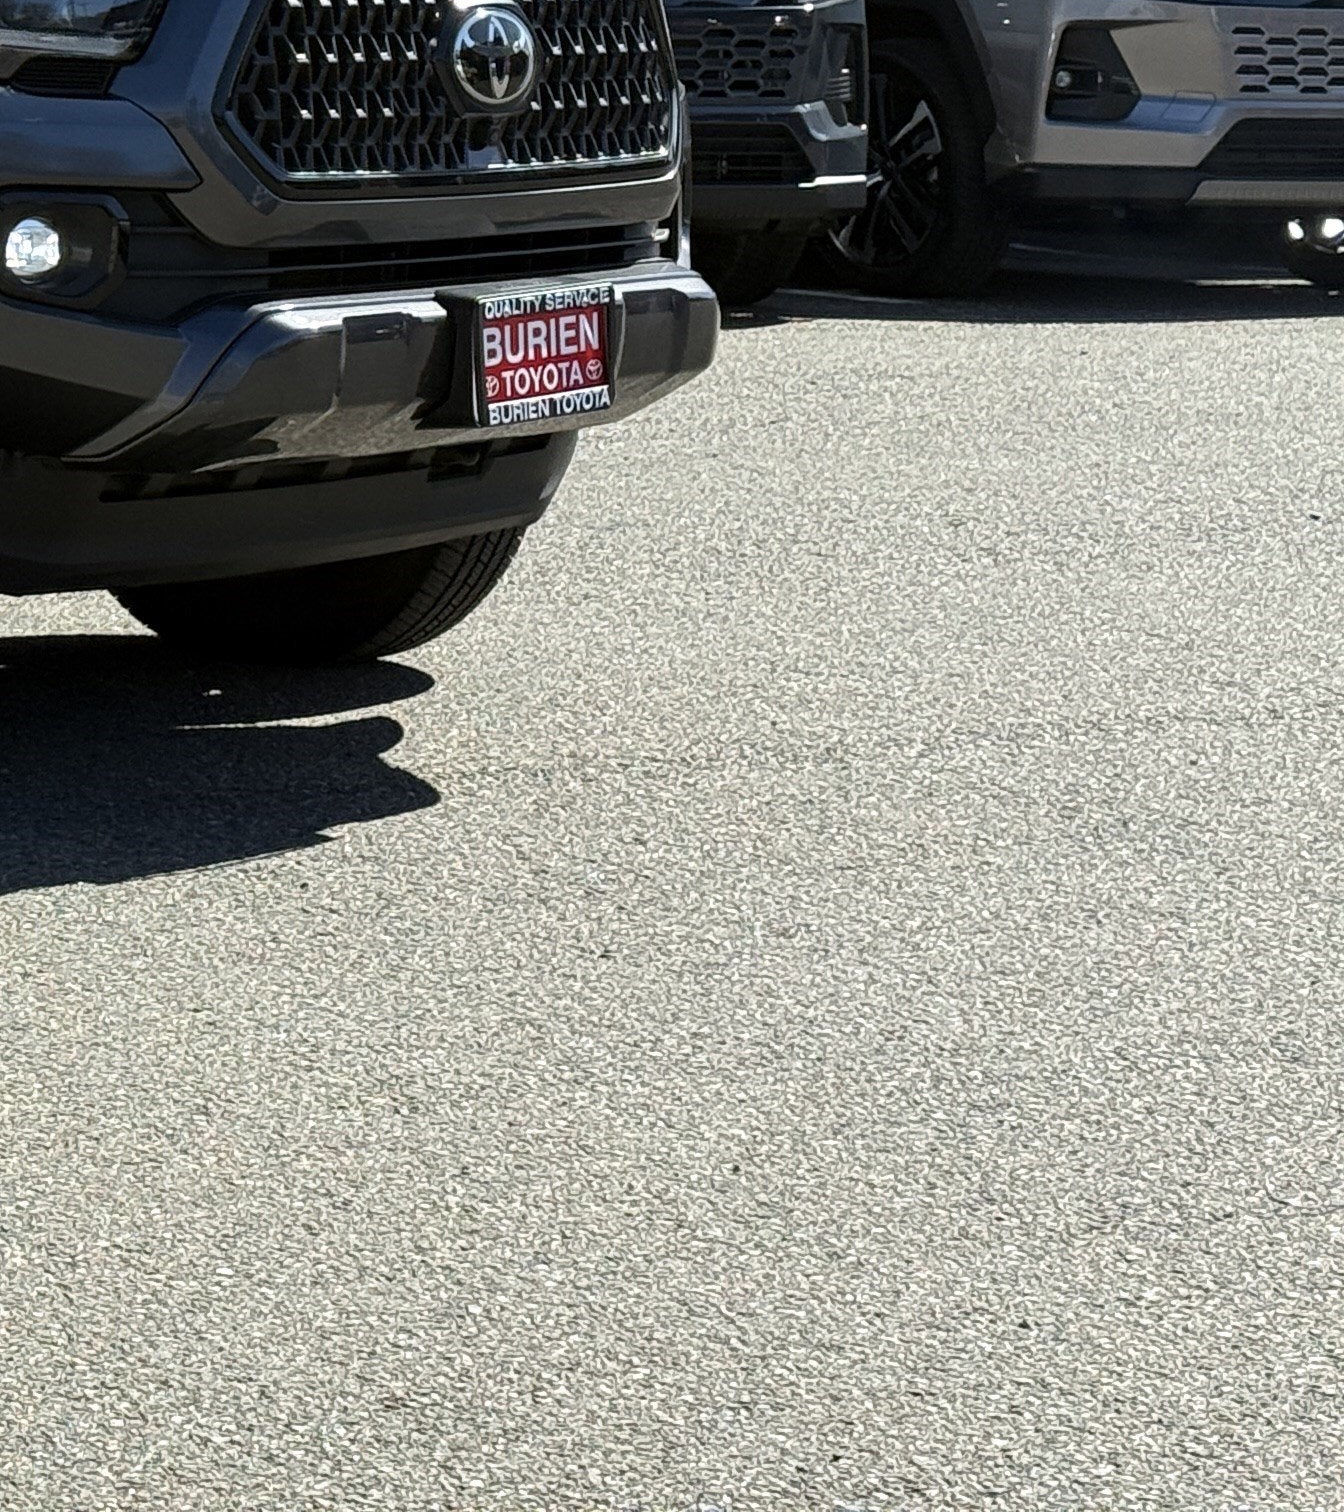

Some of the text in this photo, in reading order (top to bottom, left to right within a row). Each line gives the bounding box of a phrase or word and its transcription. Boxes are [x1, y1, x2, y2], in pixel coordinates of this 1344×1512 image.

[484, 287, 611, 320] QUALITY SERVICE
[482, 311, 600, 368] BURIEN
[501, 359, 584, 397] TOYOTA
[488, 390, 611, 426] BURIEN TOYOTA
